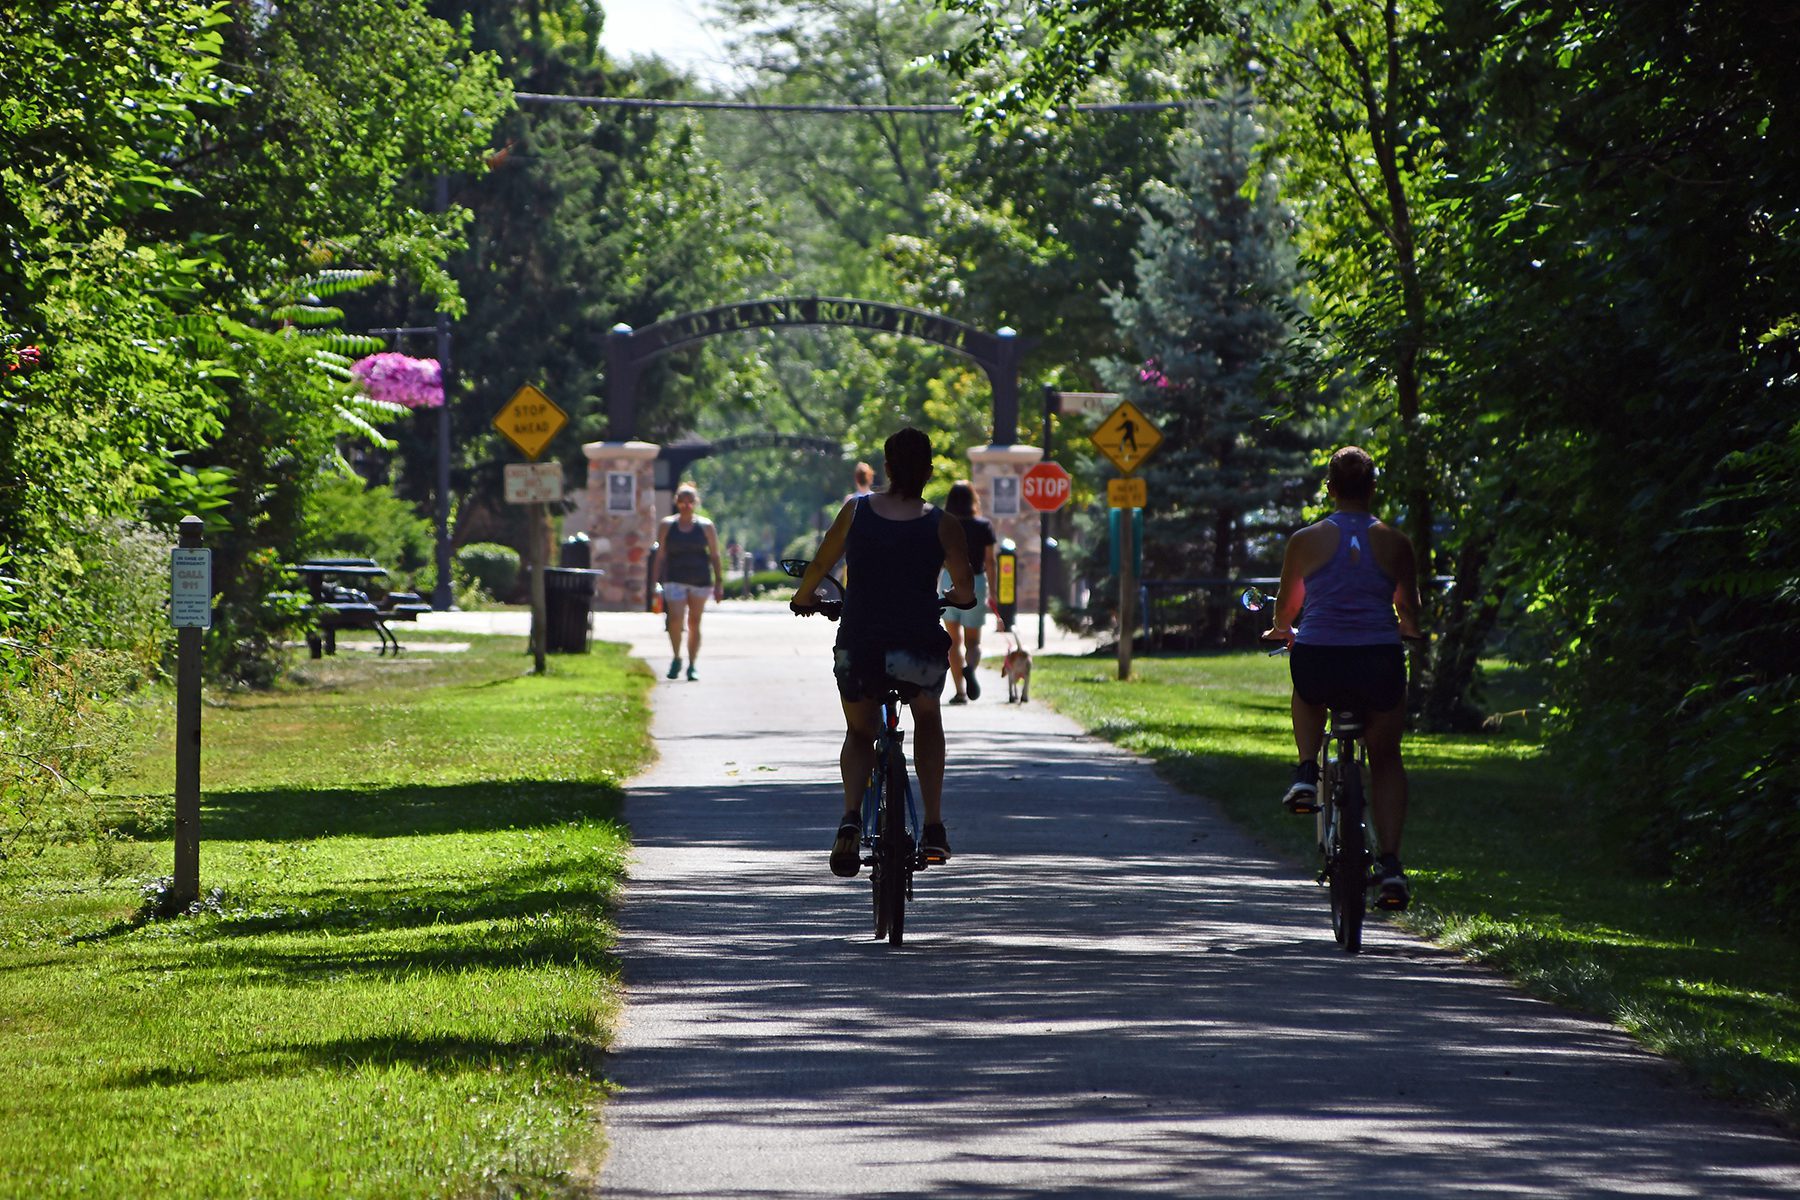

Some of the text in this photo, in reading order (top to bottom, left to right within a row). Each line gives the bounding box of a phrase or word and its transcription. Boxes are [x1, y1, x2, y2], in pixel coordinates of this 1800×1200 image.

[718, 302, 806, 330] PLANK
[816, 300, 884, 326] ROAD
[514, 404, 546, 417] STOP
[514, 421, 549, 434] AHEAD
[1024, 477, 1069, 497] STOP
[177, 570, 204, 579] CALL
[182, 581, 199, 590] 911
